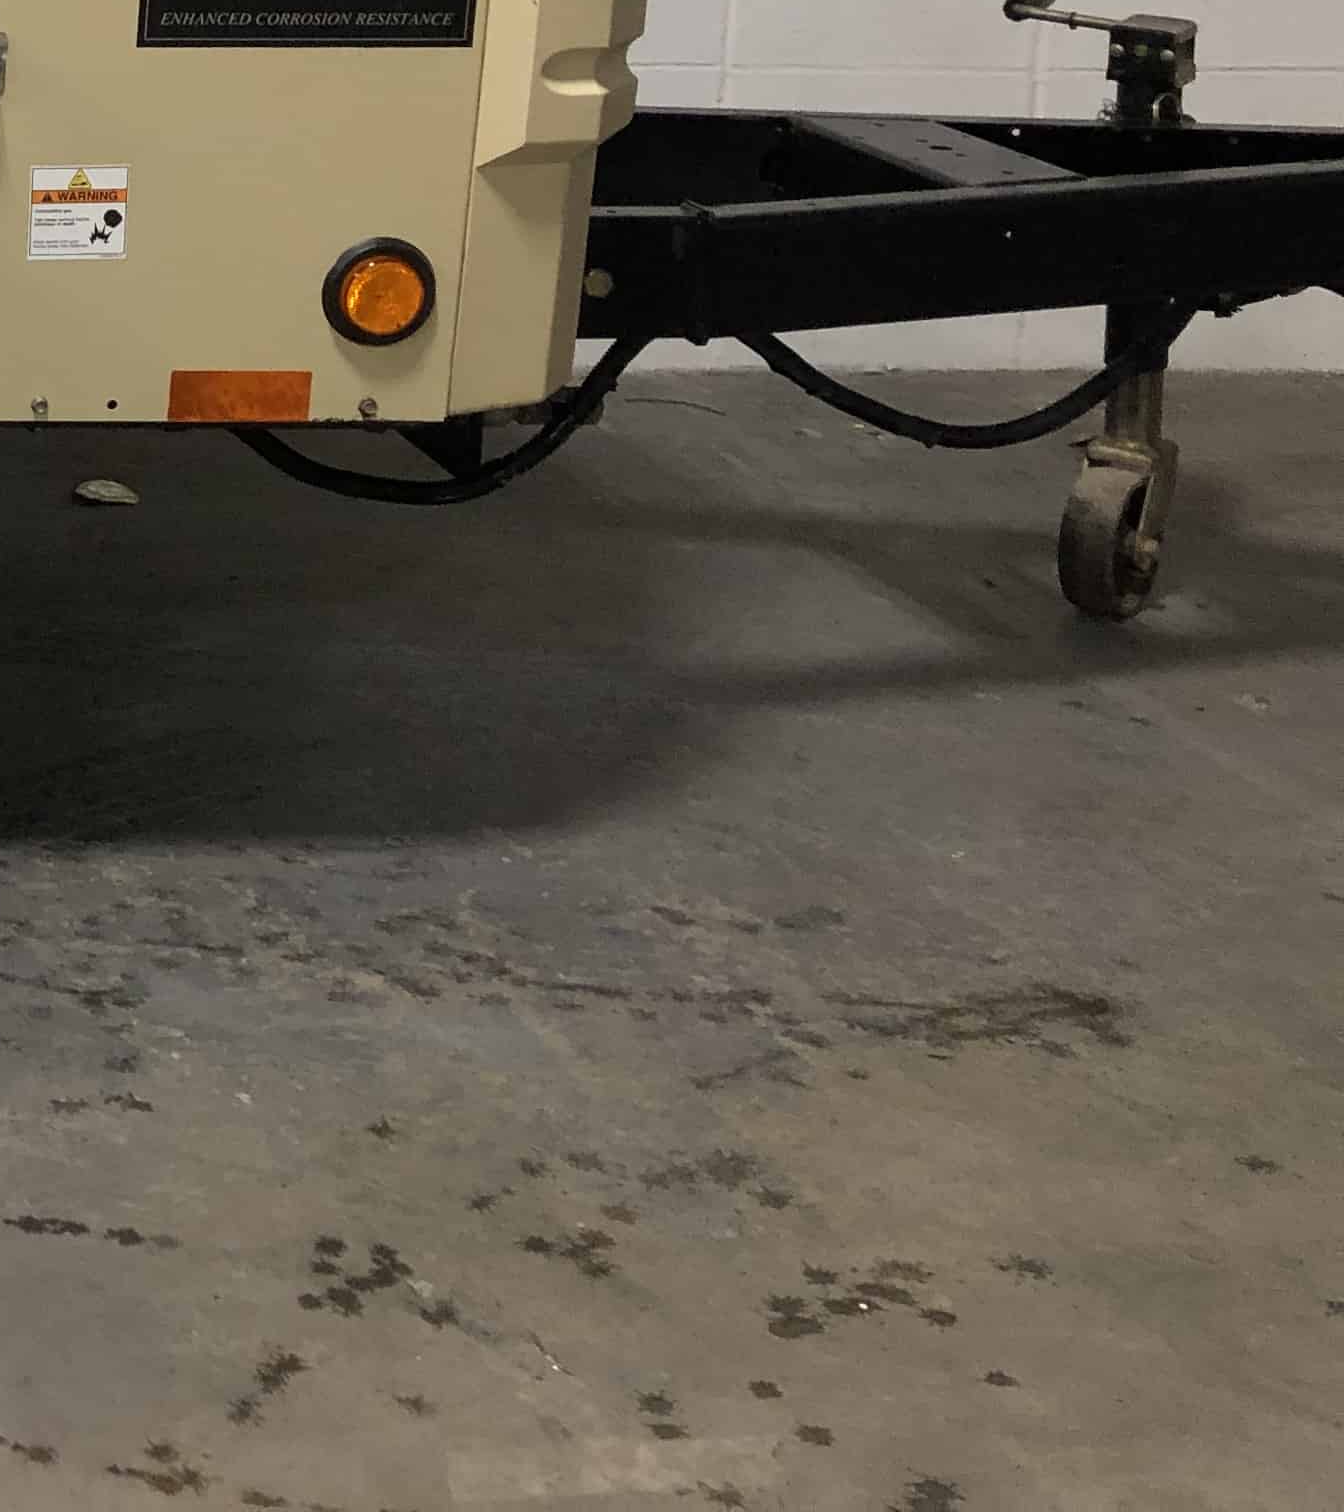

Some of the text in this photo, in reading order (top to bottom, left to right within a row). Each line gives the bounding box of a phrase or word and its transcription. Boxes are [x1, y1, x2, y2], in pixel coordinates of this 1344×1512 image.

[160, 11, 454, 26] ENHANCED CORROSION RESISTANCE
[58, 190, 118, 201] WARNING
